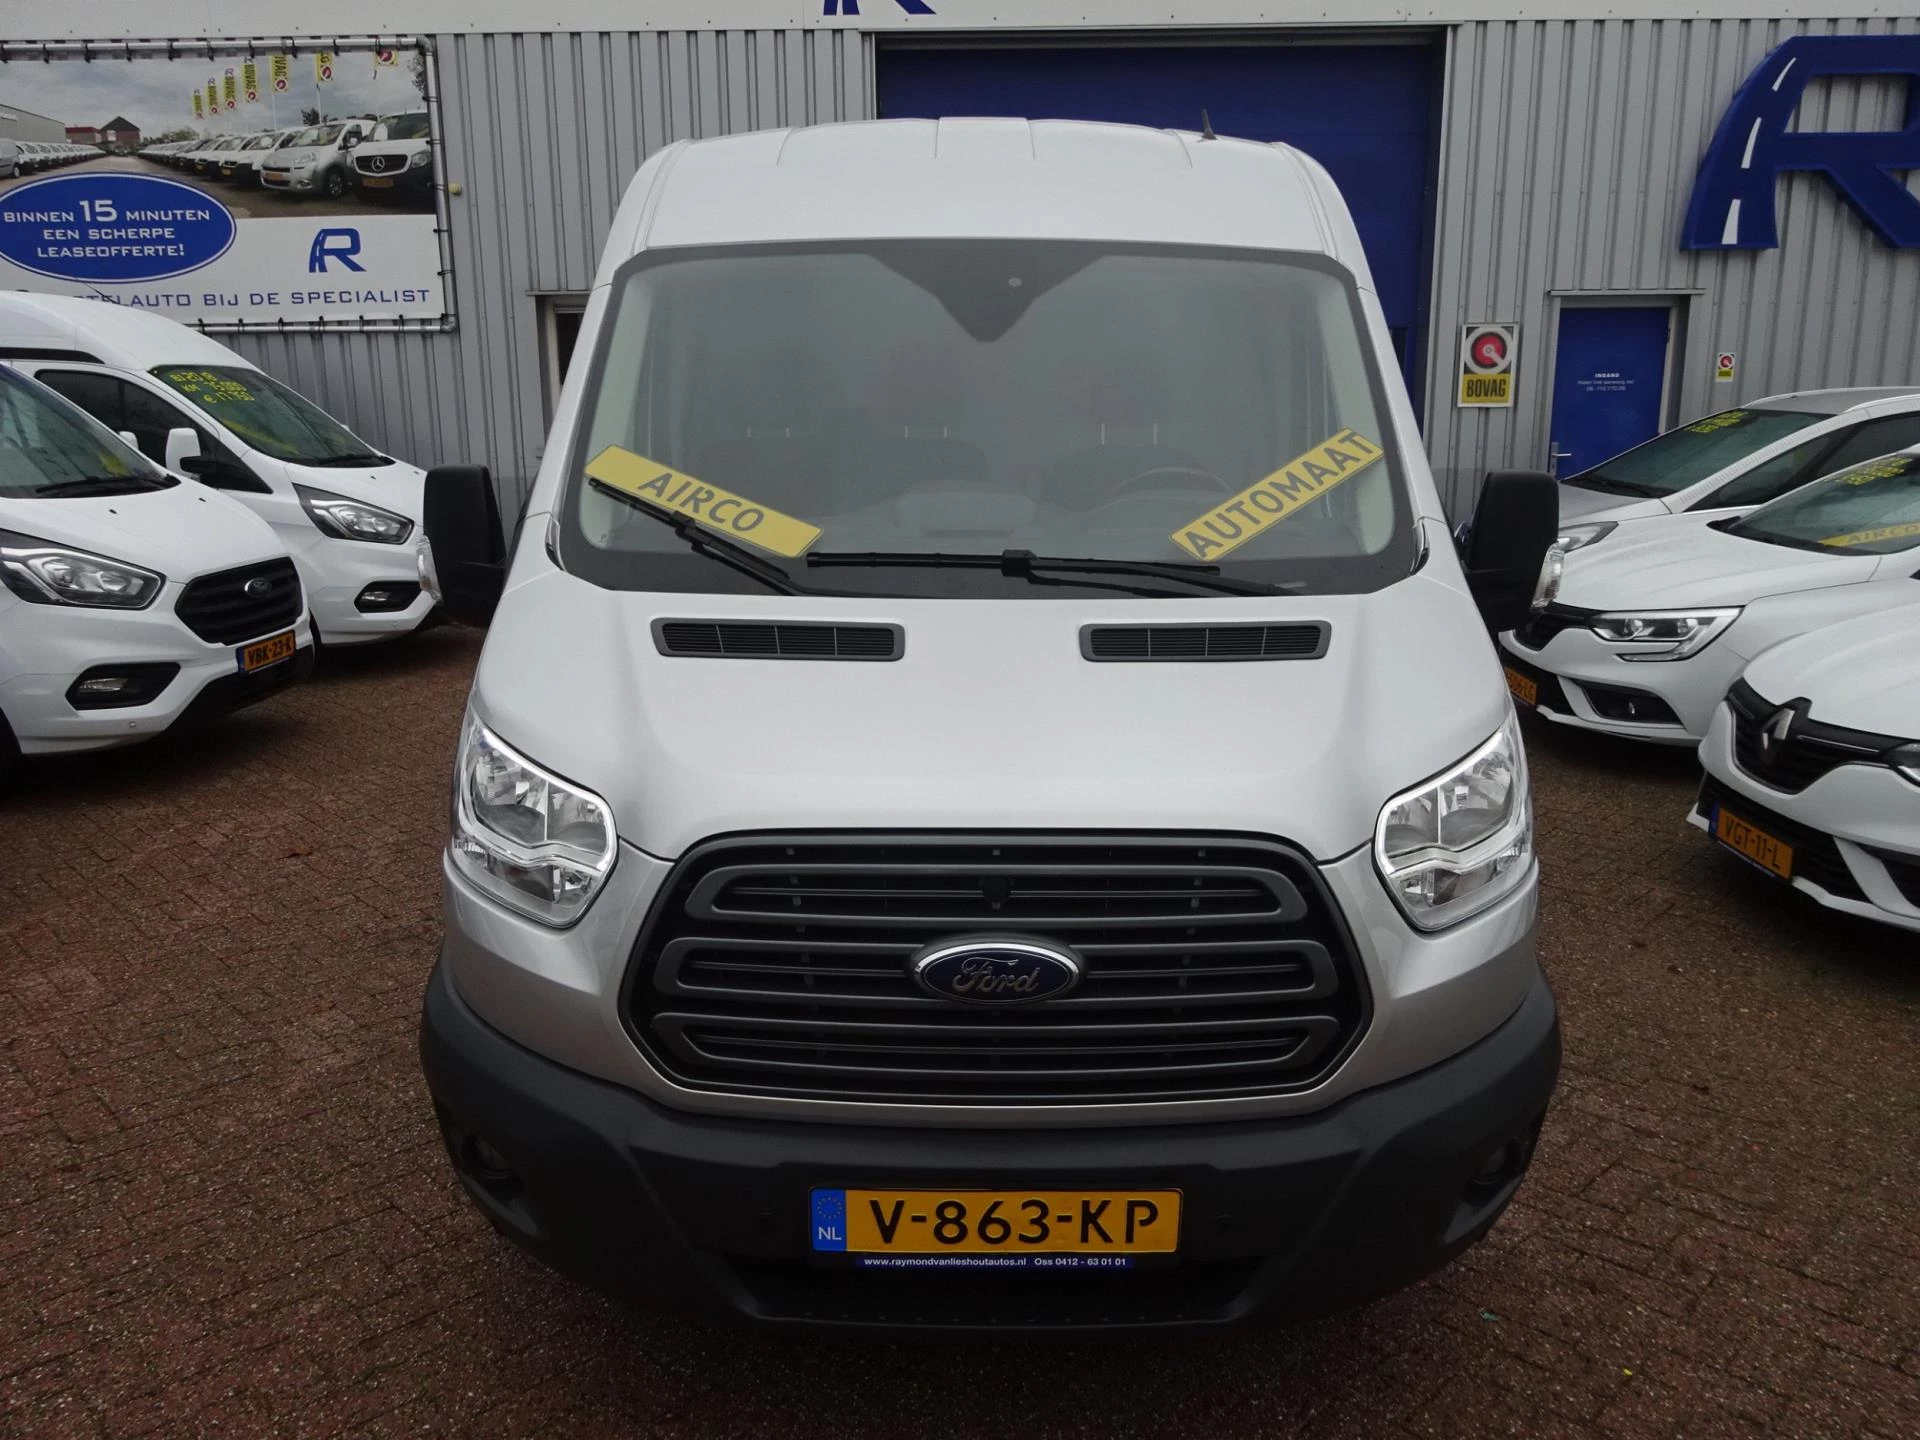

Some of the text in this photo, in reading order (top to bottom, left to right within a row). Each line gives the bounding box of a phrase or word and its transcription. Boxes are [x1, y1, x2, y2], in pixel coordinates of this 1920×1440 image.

[4, 200, 210, 222] BINNEN 15 MINUTEN
[43, 227, 175, 240] EEN SCHERPE
[37, 243, 185, 258] LEASEOFFERTE!
[204, 293, 239, 306] BIJ
[250, 293, 280, 305] DE
[291, 290, 430, 304] SPECIALIST
[1466, 378, 1507, 398] BOVAG
[637, 472, 765, 532] AIRCO
[1184, 431, 1374, 558] AUTOMAAT
[1847, 524, 1919, 543] AIRCO
[952, 956, 1041, 993] Ford
[818, 1198, 1159, 1245] NL V-863-KP
[864, 1257, 1027, 1268] www.raymondvanlieshoutautos.nl
[1034, 1257, 1052, 1267] Oss
[1055, 1257, 1079, 1267] 0412
[1087, 1257, 1099, 1267] 63
[1101, 1257, 1112, 1267] 01
[1115, 1257, 1127, 1267] 01
